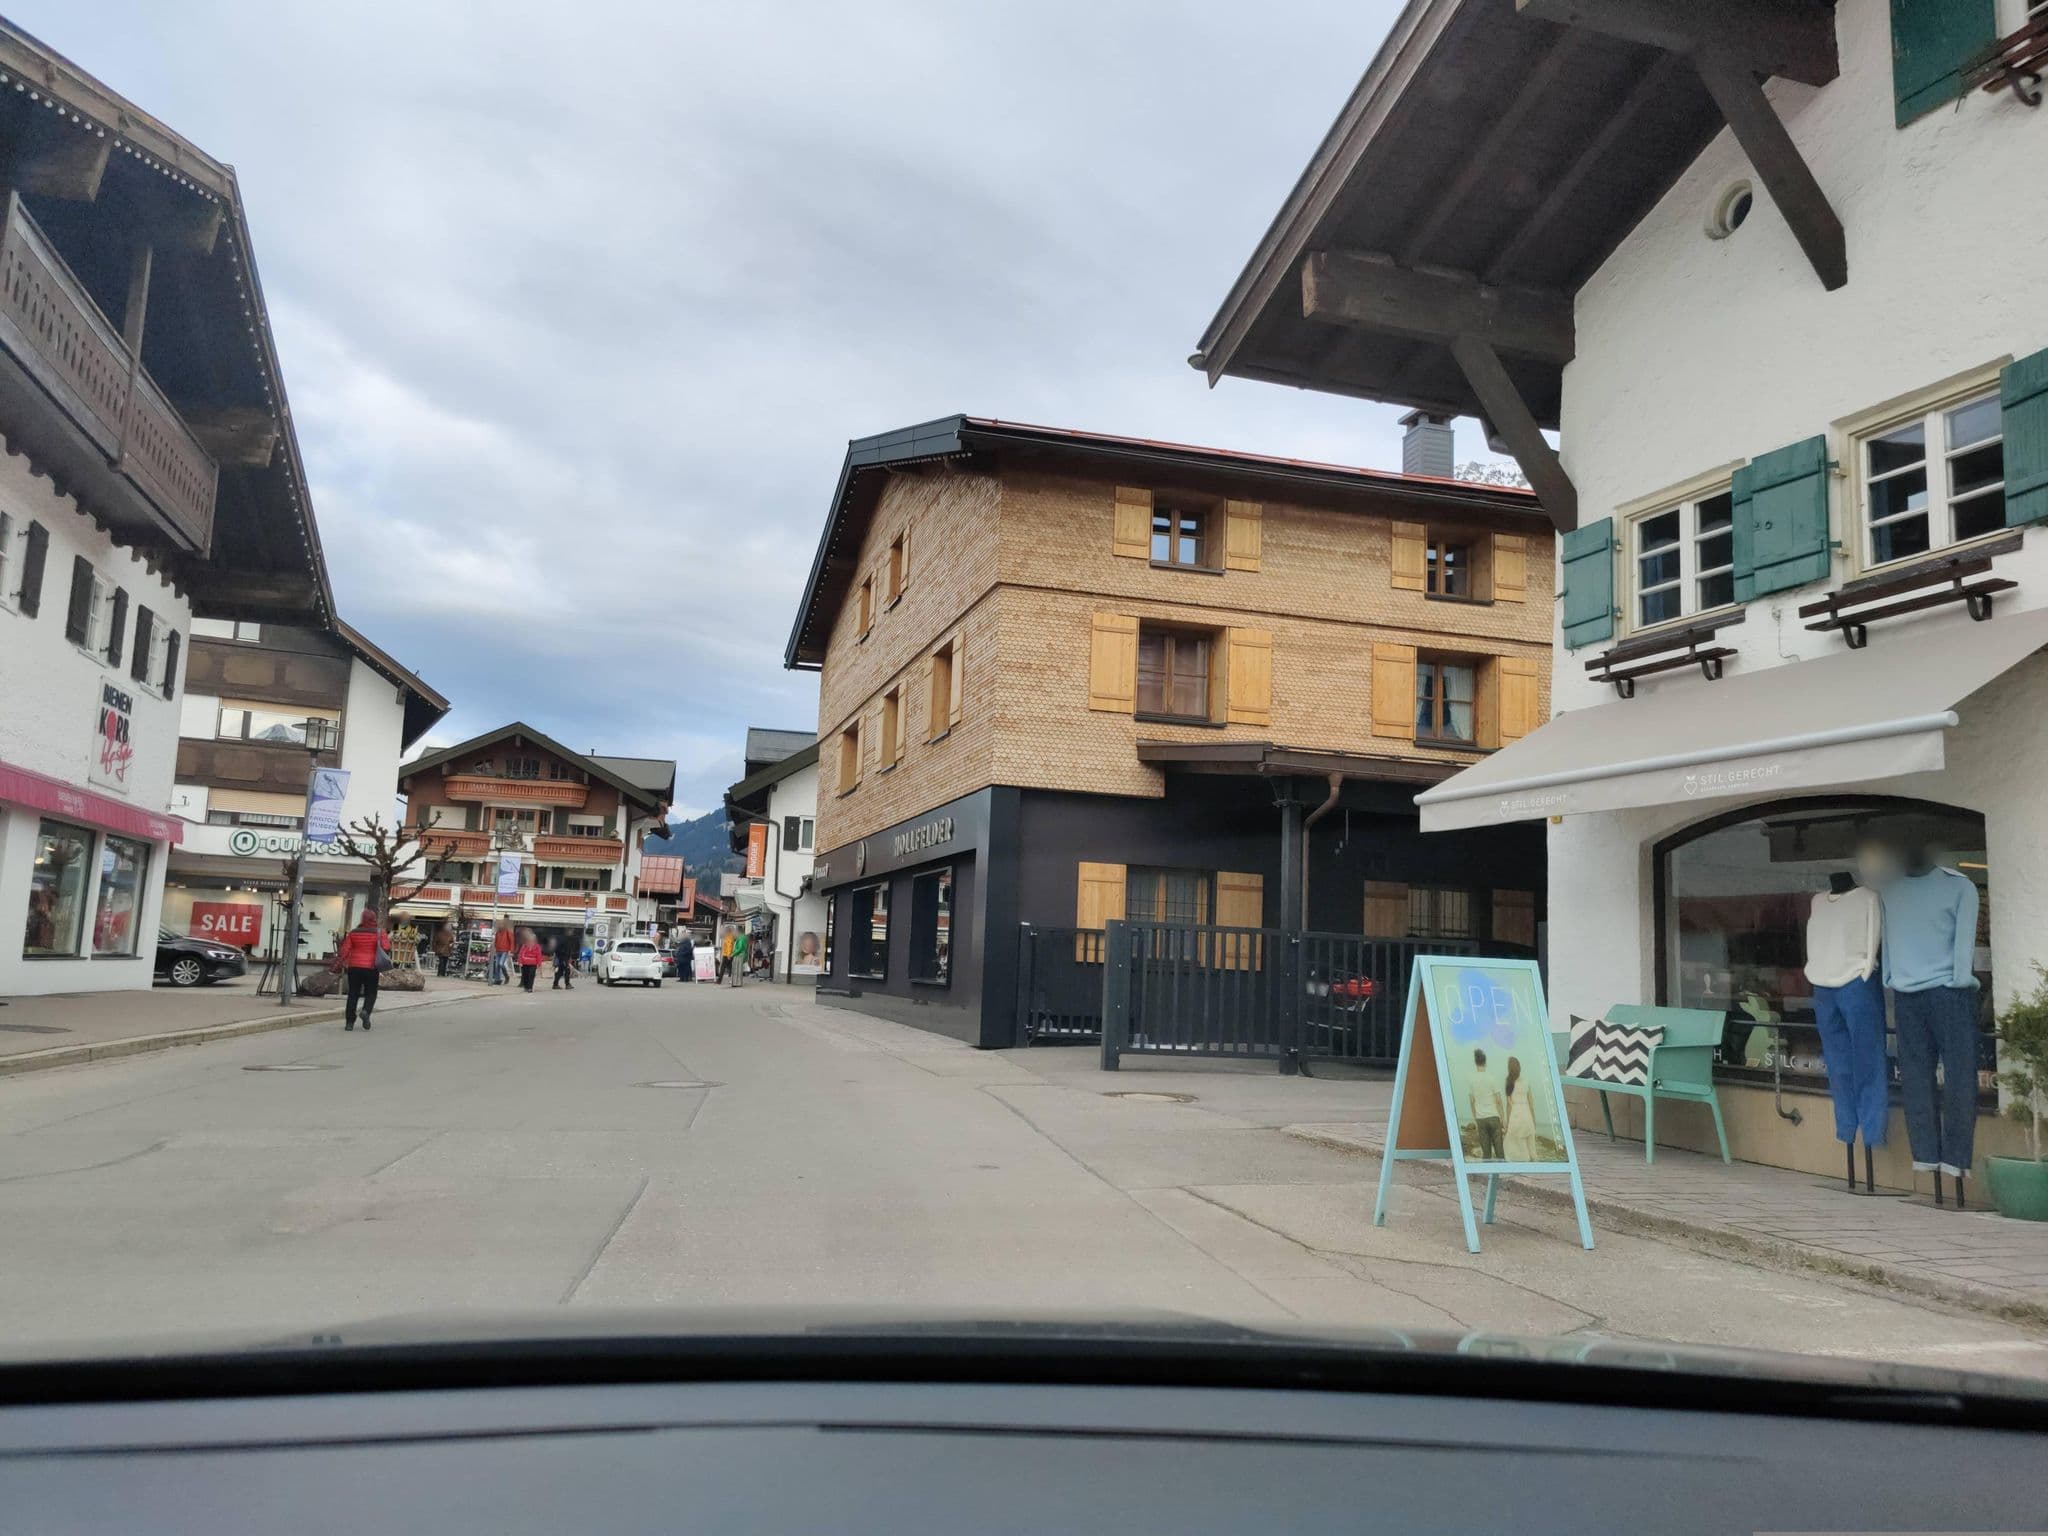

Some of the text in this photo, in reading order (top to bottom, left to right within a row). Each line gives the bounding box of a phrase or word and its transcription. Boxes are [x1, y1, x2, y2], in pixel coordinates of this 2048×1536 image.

[103, 683, 134, 716] BIENEN
[99, 706, 130, 743] KORB
[894, 816, 953, 857] HOLLFELDER
[201, 914, 253, 932] SALE
